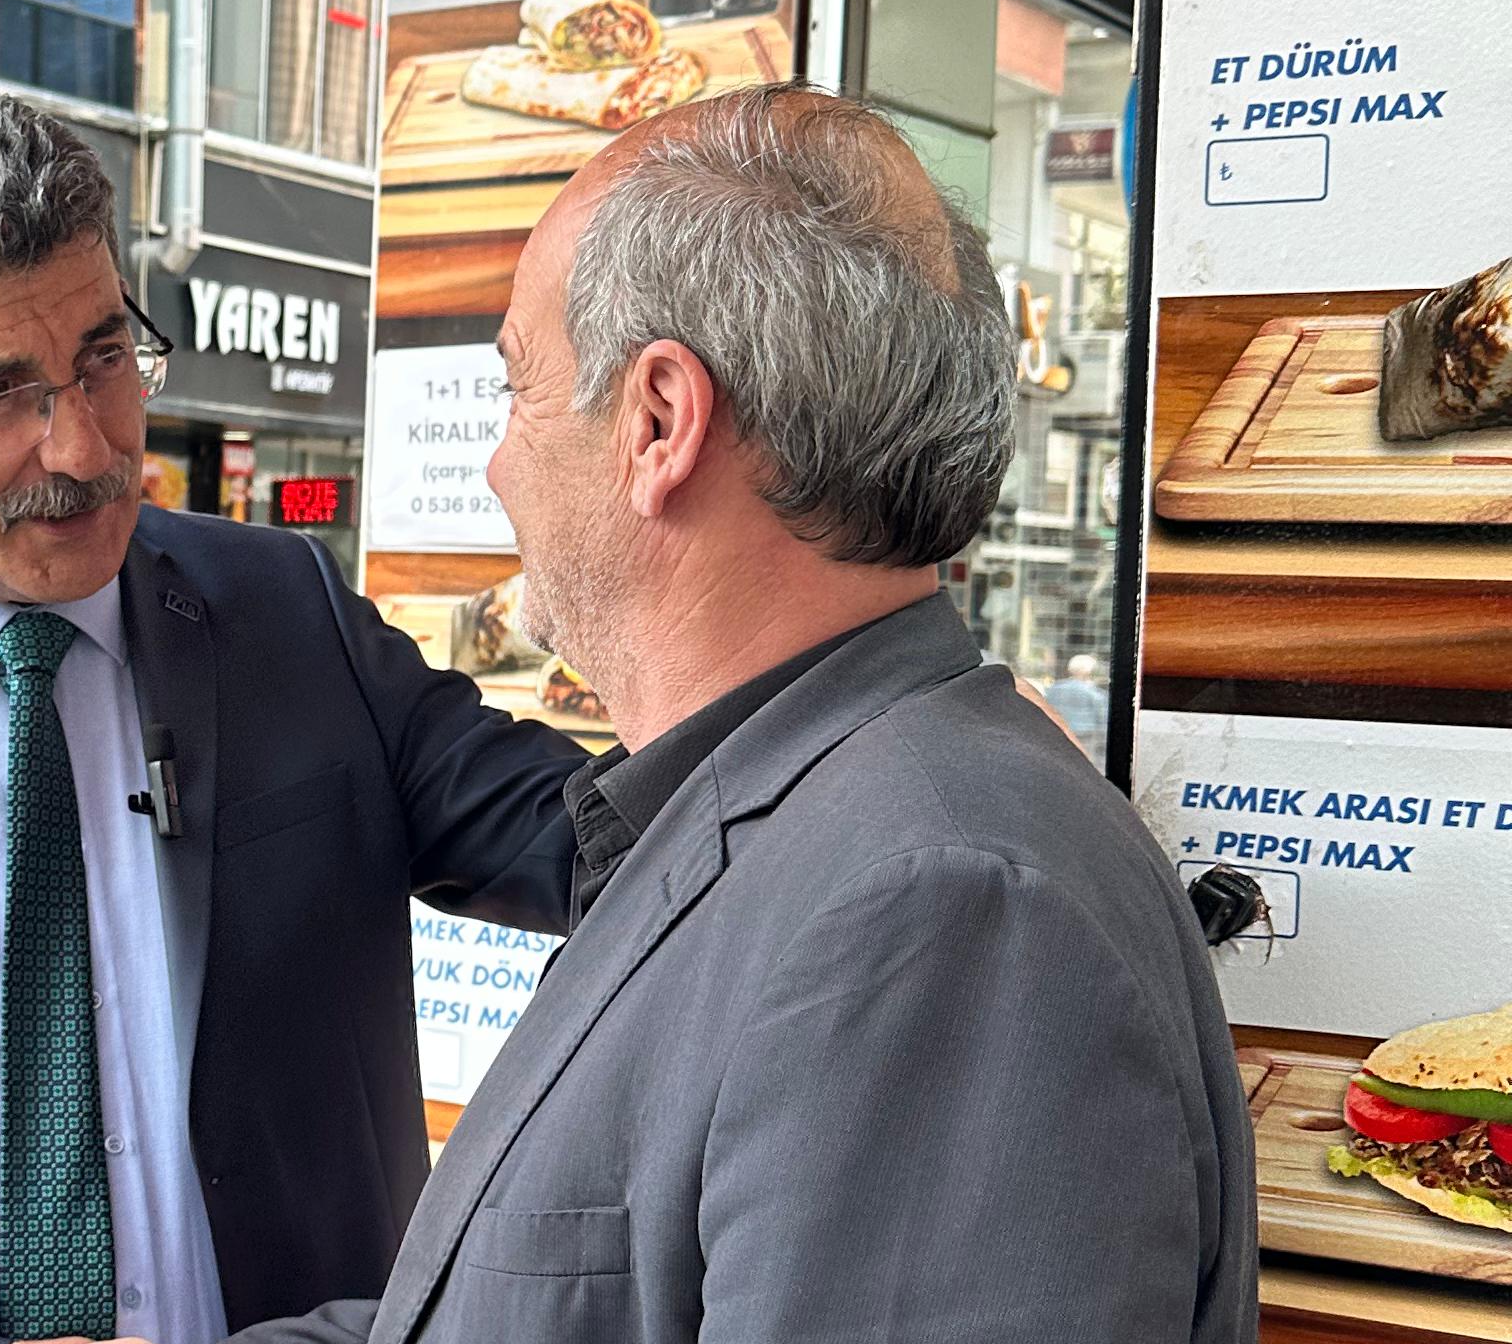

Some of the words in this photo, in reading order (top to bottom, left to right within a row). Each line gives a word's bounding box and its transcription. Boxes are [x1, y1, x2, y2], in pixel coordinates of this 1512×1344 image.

[1211, 56, 1250, 85] ET
[1258, 38, 1397, 82] DÜRÜM
[1210, 113, 1230, 132] +
[1243, 97, 1342, 131] PEPSI
[1350, 90, 1448, 124] MAX
[188, 277, 341, 364] YAREN
[425, 378, 461, 401] 1+1
[407, 416, 500, 444] KİRALIK
[422, 461, 488, 484] (çarşı-
[410, 496, 423, 514] 0
[428, 496, 464, 514] 536
[1182, 782, 1308, 816] EKMEK
[1315, 792, 1432, 825] ARASI
[1442, 800, 1486, 828] ET
[1181, 836, 1200, 854] +
[1214, 831, 1312, 864] PEPSI
[1320, 841, 1416, 873] MAX
